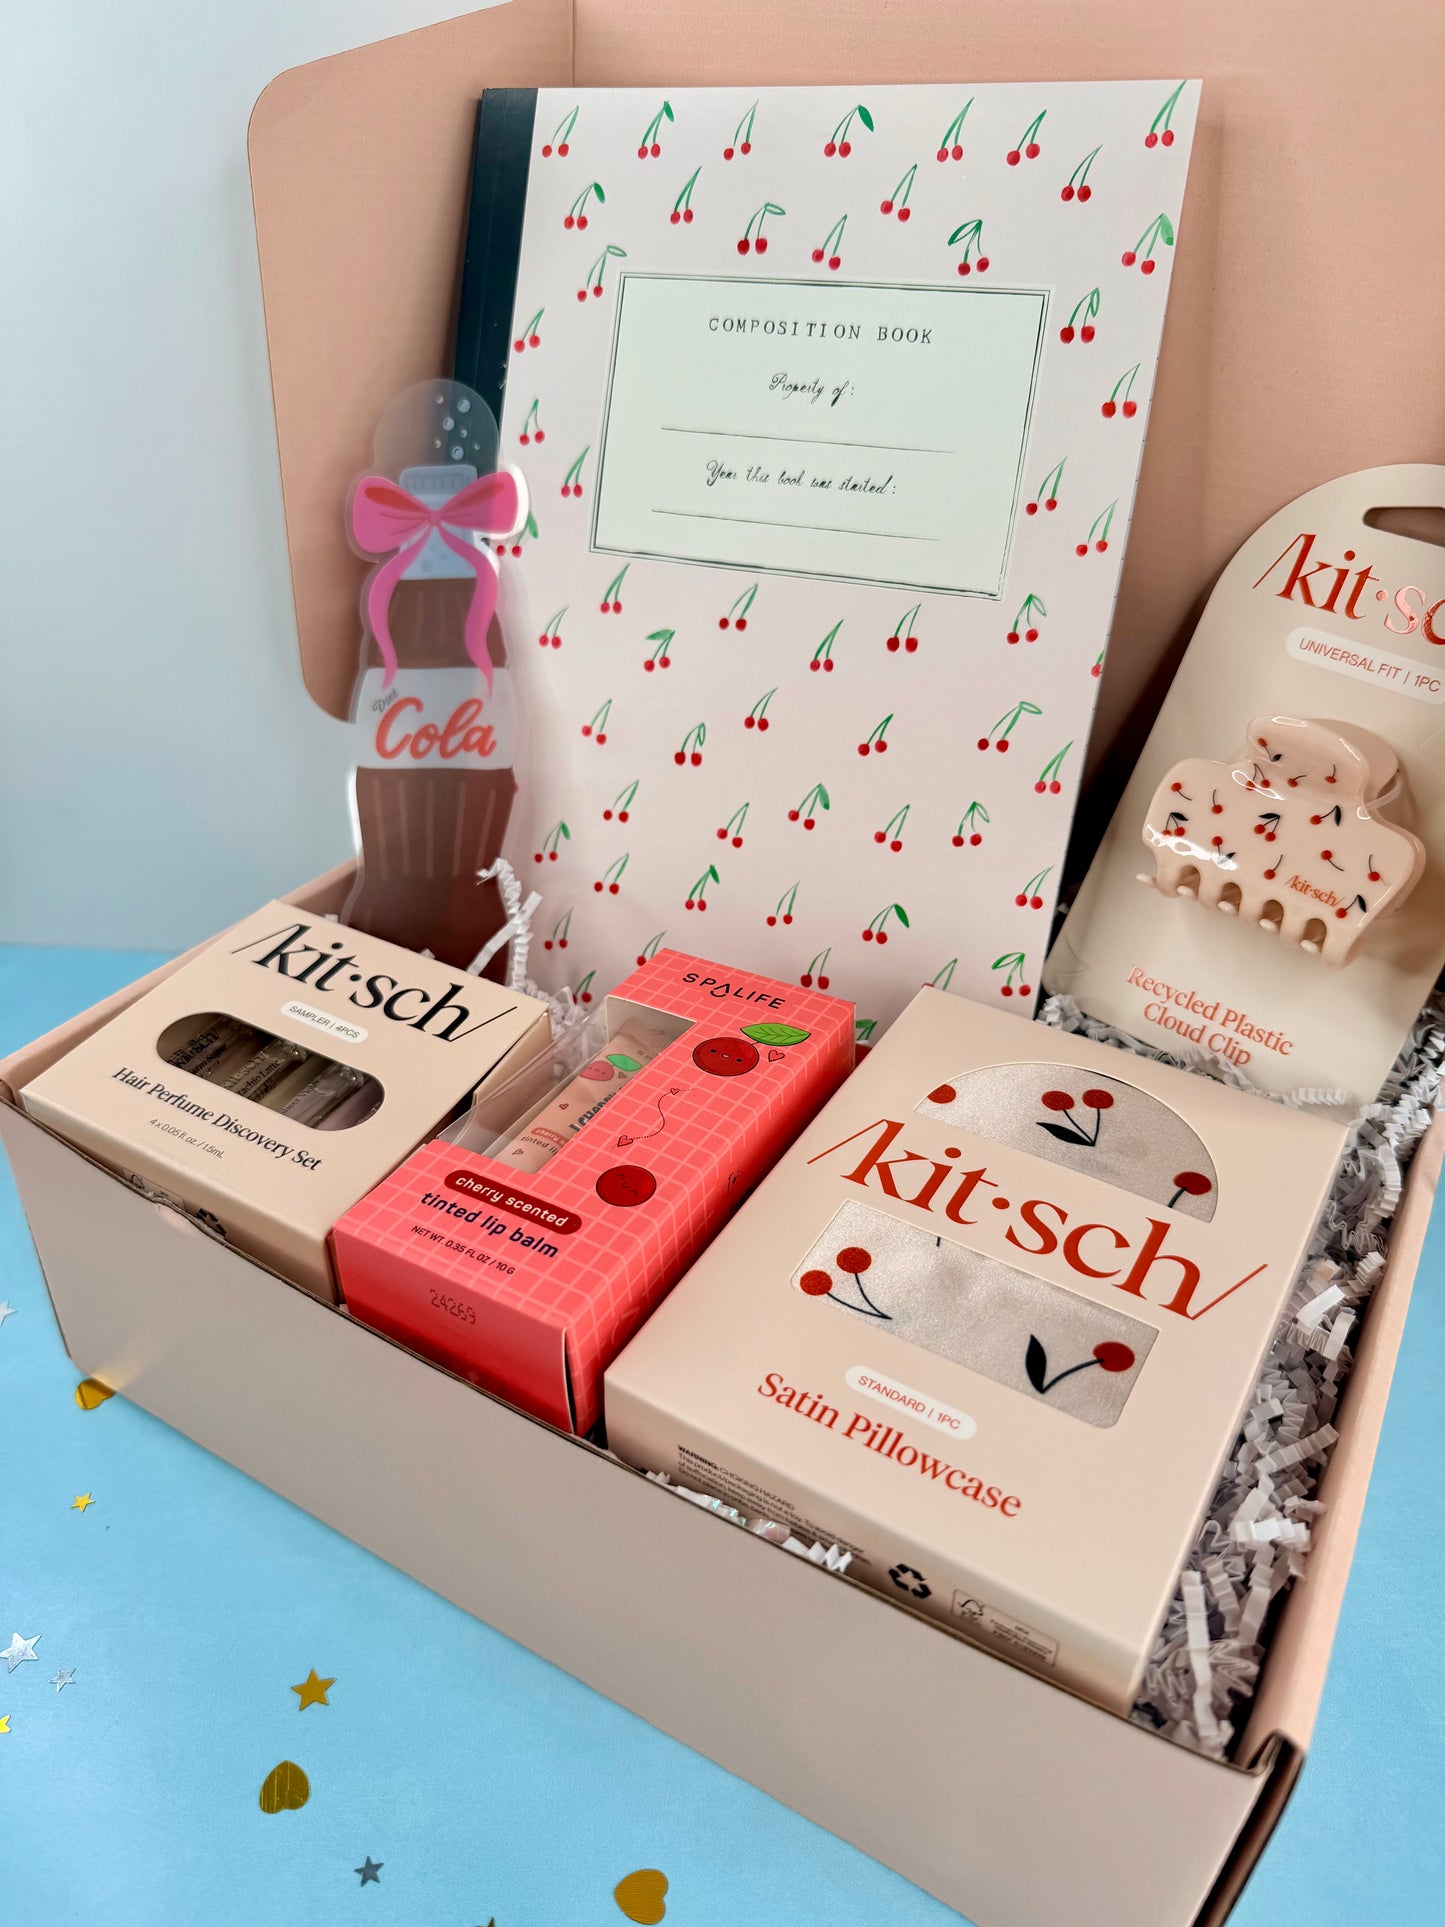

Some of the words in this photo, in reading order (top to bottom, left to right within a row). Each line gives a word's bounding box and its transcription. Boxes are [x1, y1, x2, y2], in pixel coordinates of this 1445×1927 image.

[709, 317, 861, 339] COMPOSITION
[877, 326, 932, 344] BOOK
[769, 372, 824, 404] Property
[707, 460, 737, 486] Year
[747, 466, 769, 482] this
[778, 471, 805, 486] book
[811, 478, 832, 489] was
[838, 475, 896, 494] started:
[1298, 638, 1375, 672] UNIVERSAL
[1377, 663, 1402, 680] FIT
[1414, 675, 1441, 692] 1PC
[375, 696, 497, 760] Cola
[682, 973, 785, 1009] SPALIFE
[1125, 965, 1221, 1021] Recycled
[1219, 1008, 1294, 1056] Plastic
[289, 1006, 331, 1028] SAMPLER
[335, 1025, 361, 1039] 4PCS
[1143, 1002, 1208, 1045] Cloud
[1208, 1032, 1252, 1067] Clip
[112, 1067, 151, 1090] Hair
[147, 1083, 214, 1121] Perfume
[212, 1113, 294, 1159] Discovery
[291, 1150, 323, 1171] Set
[521, 1136, 550, 1149] tinted
[420, 1192, 482, 1223] tinted
[480, 1215, 507, 1236] lip
[509, 1227, 559, 1258] balm
[455, 1176, 504, 1202] cherry
[505, 1195, 569, 1227] scented
[411, 1225, 431, 1237] NET
[430, 1232, 444, 1244] WT.
[445, 1239, 467, 1253] 0.35
[464, 1248, 476, 1258] FL
[476, 1253, 491, 1264] OZ
[496, 1262, 507, 1272] 10
[507, 1266, 516, 1275] G
[857, 1375, 926, 1413] STANDARD
[937, 1411, 961, 1430] 1PC
[757, 1372, 840, 1430] Satin
[842, 1412, 1022, 1518] Pillowcase
